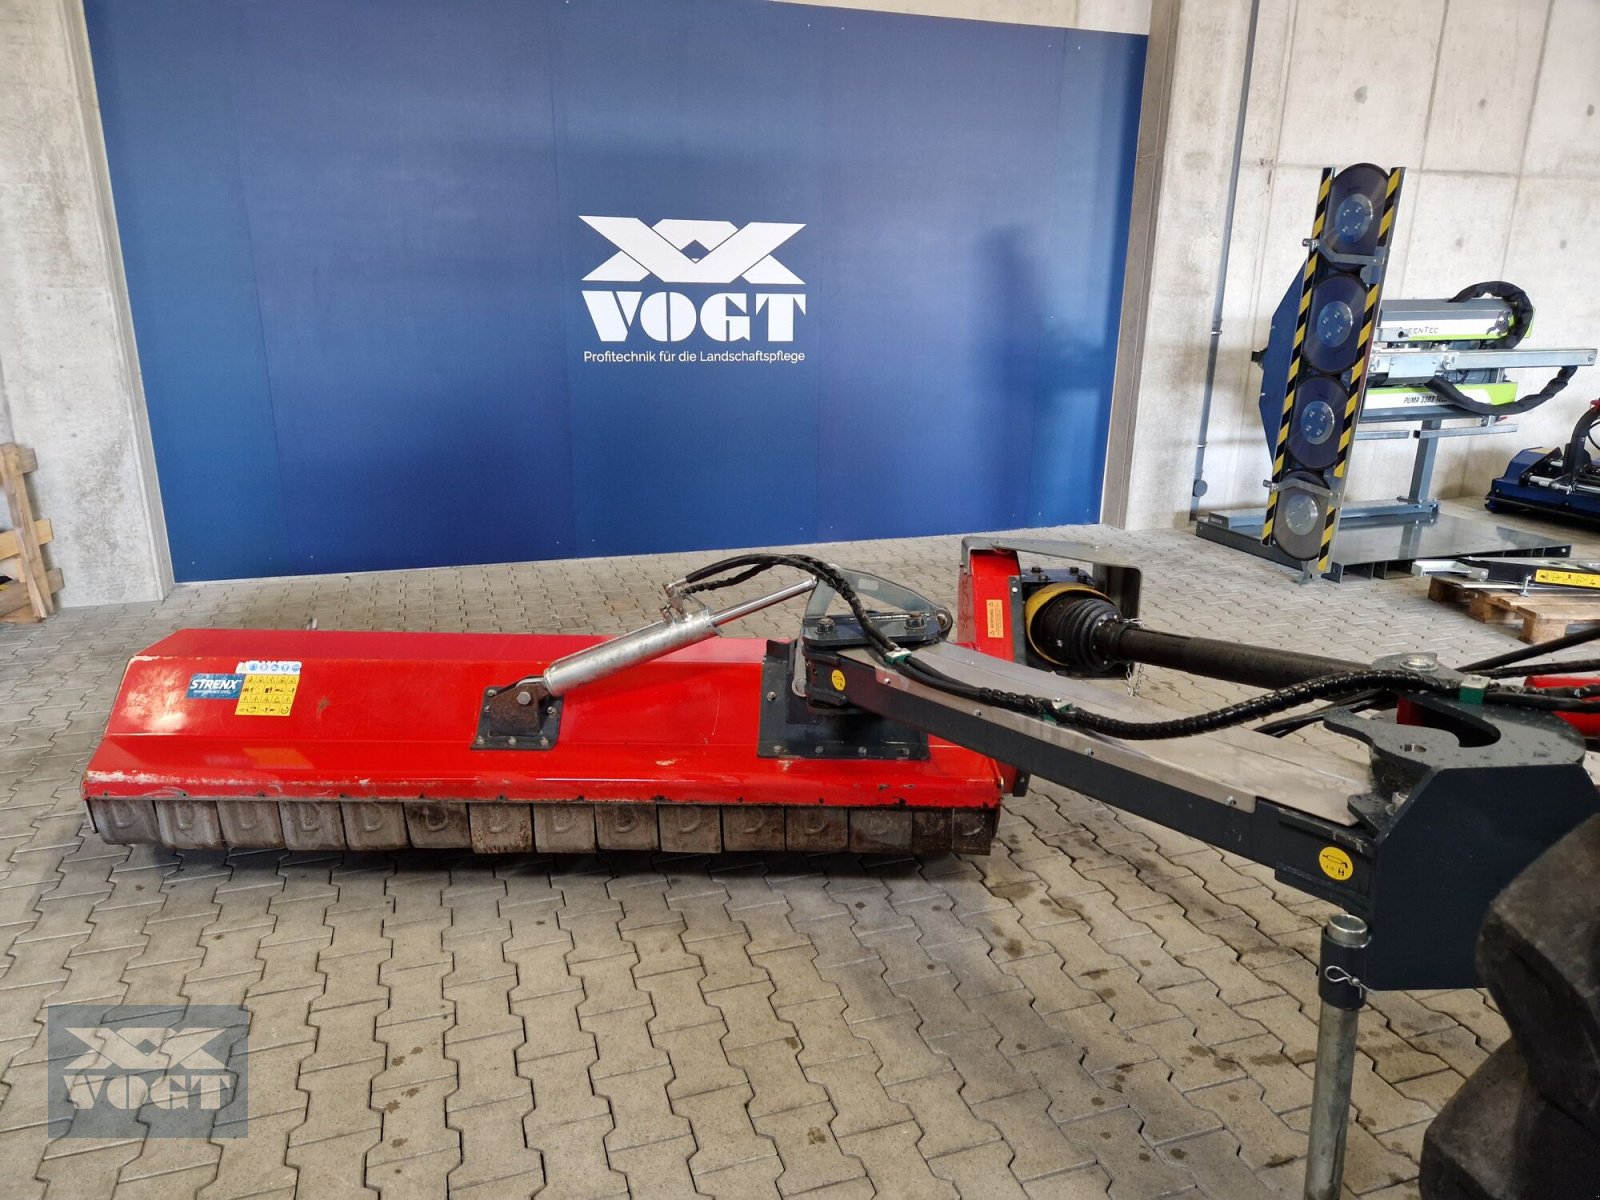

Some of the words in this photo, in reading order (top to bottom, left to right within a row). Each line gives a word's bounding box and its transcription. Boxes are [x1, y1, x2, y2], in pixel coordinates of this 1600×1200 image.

[581, 290, 807, 342] VOGT
[583, 350, 656, 363] Profitechnik
[659, 350, 676, 362] für
[678, 350, 696, 362] die
[700, 350, 805, 364] Landschaftspflege
